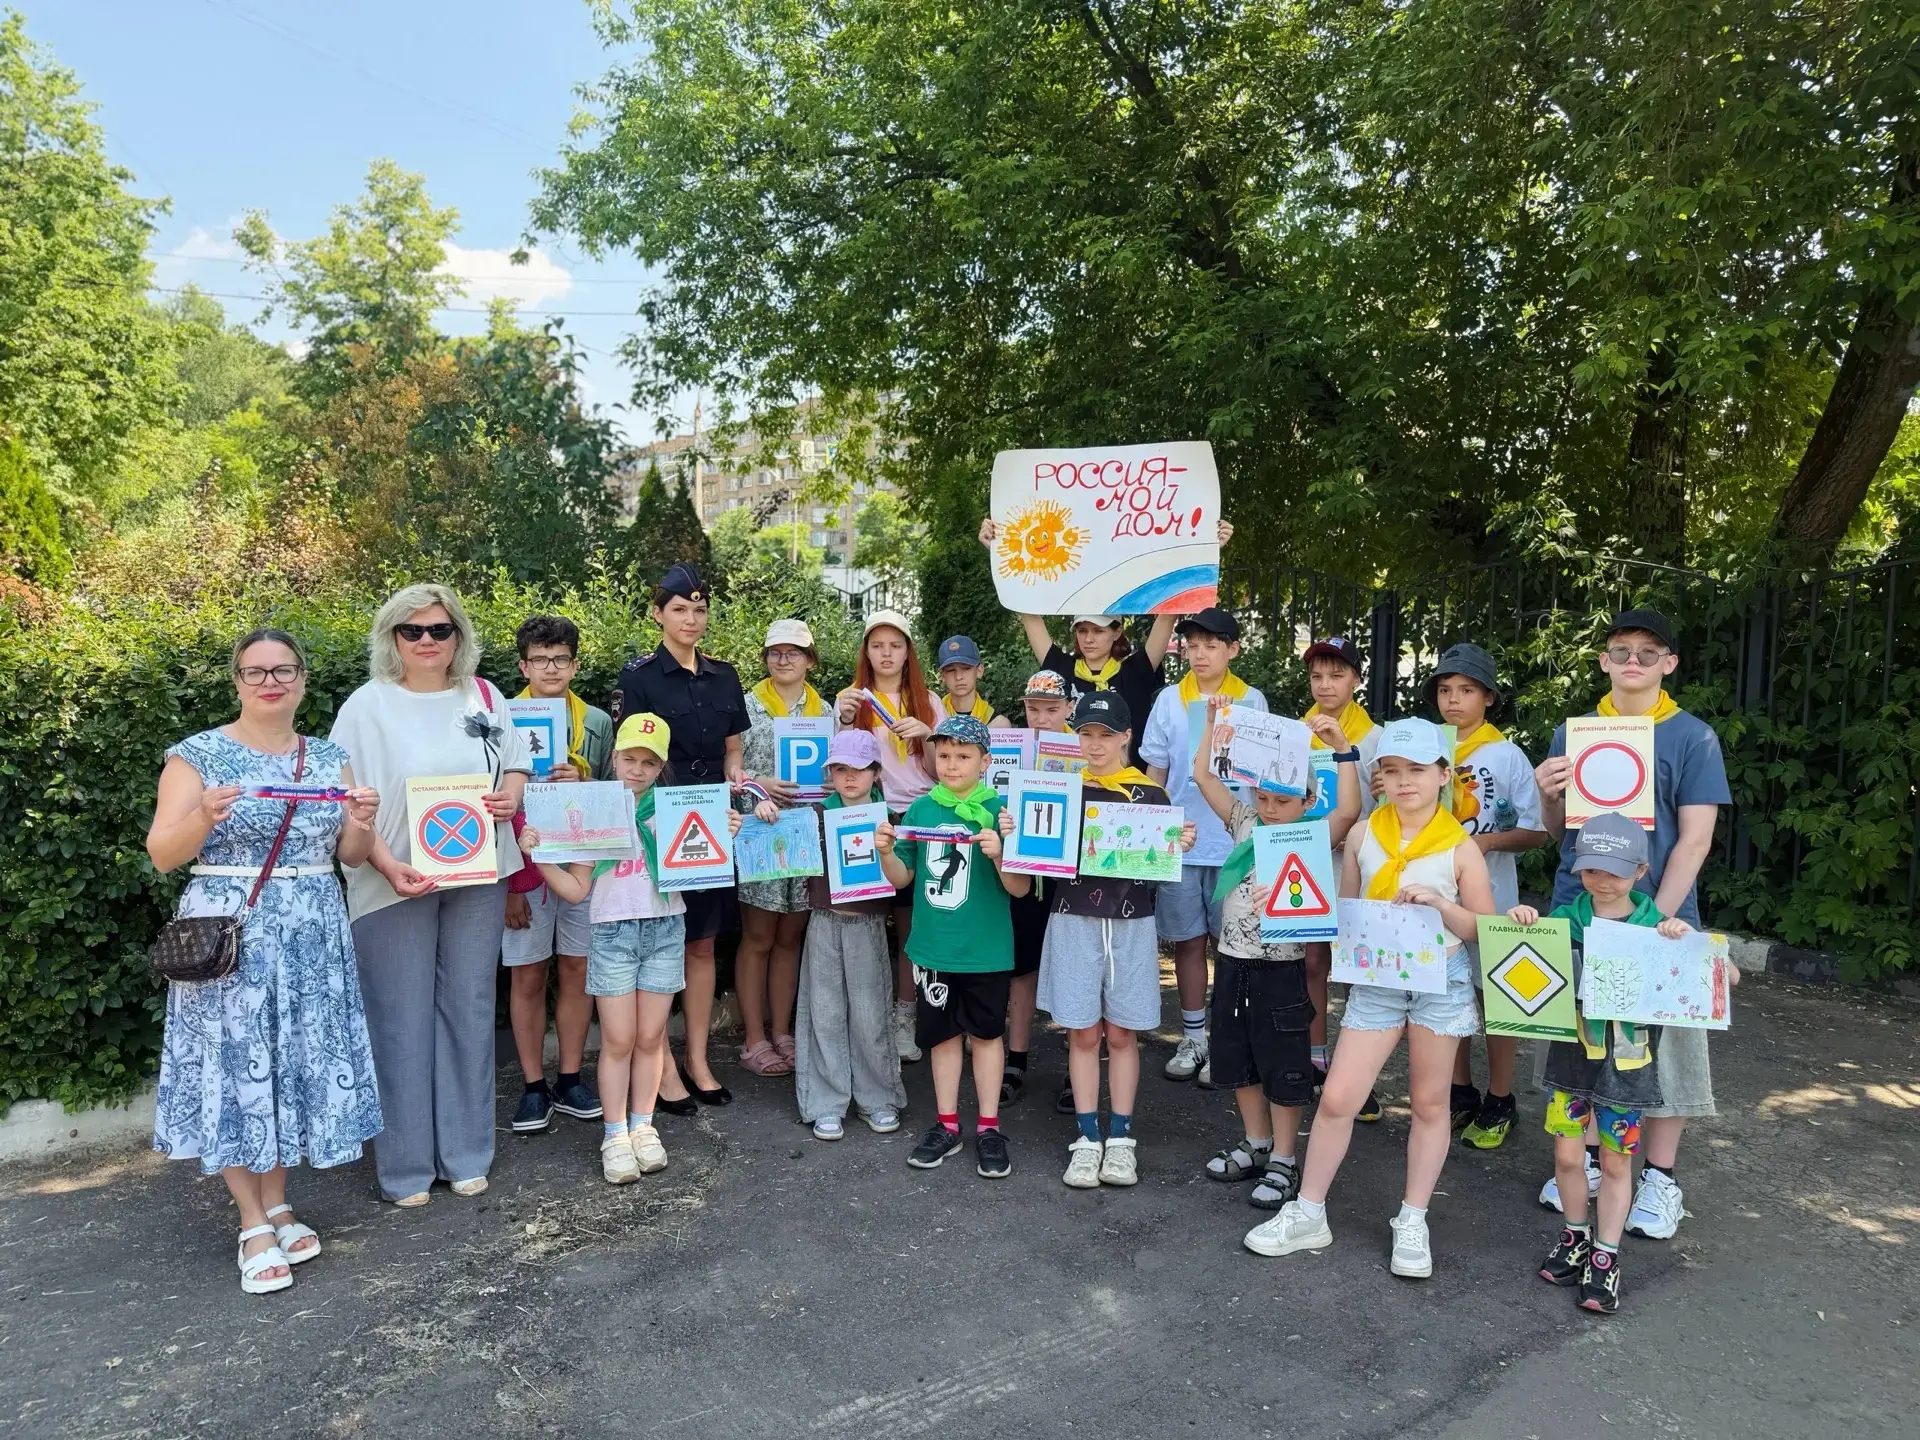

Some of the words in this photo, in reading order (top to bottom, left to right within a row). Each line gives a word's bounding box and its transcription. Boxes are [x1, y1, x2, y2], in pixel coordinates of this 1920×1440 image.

[1034, 456, 1188, 491] РОССИЯ-
[1095, 483, 1179, 512] МОЙ
[638, 719, 656, 734] B
[1271, 829, 1310, 838] СВЕТОФОРНОЕ
[1526, 927, 1558, 935] ДОРОГА
